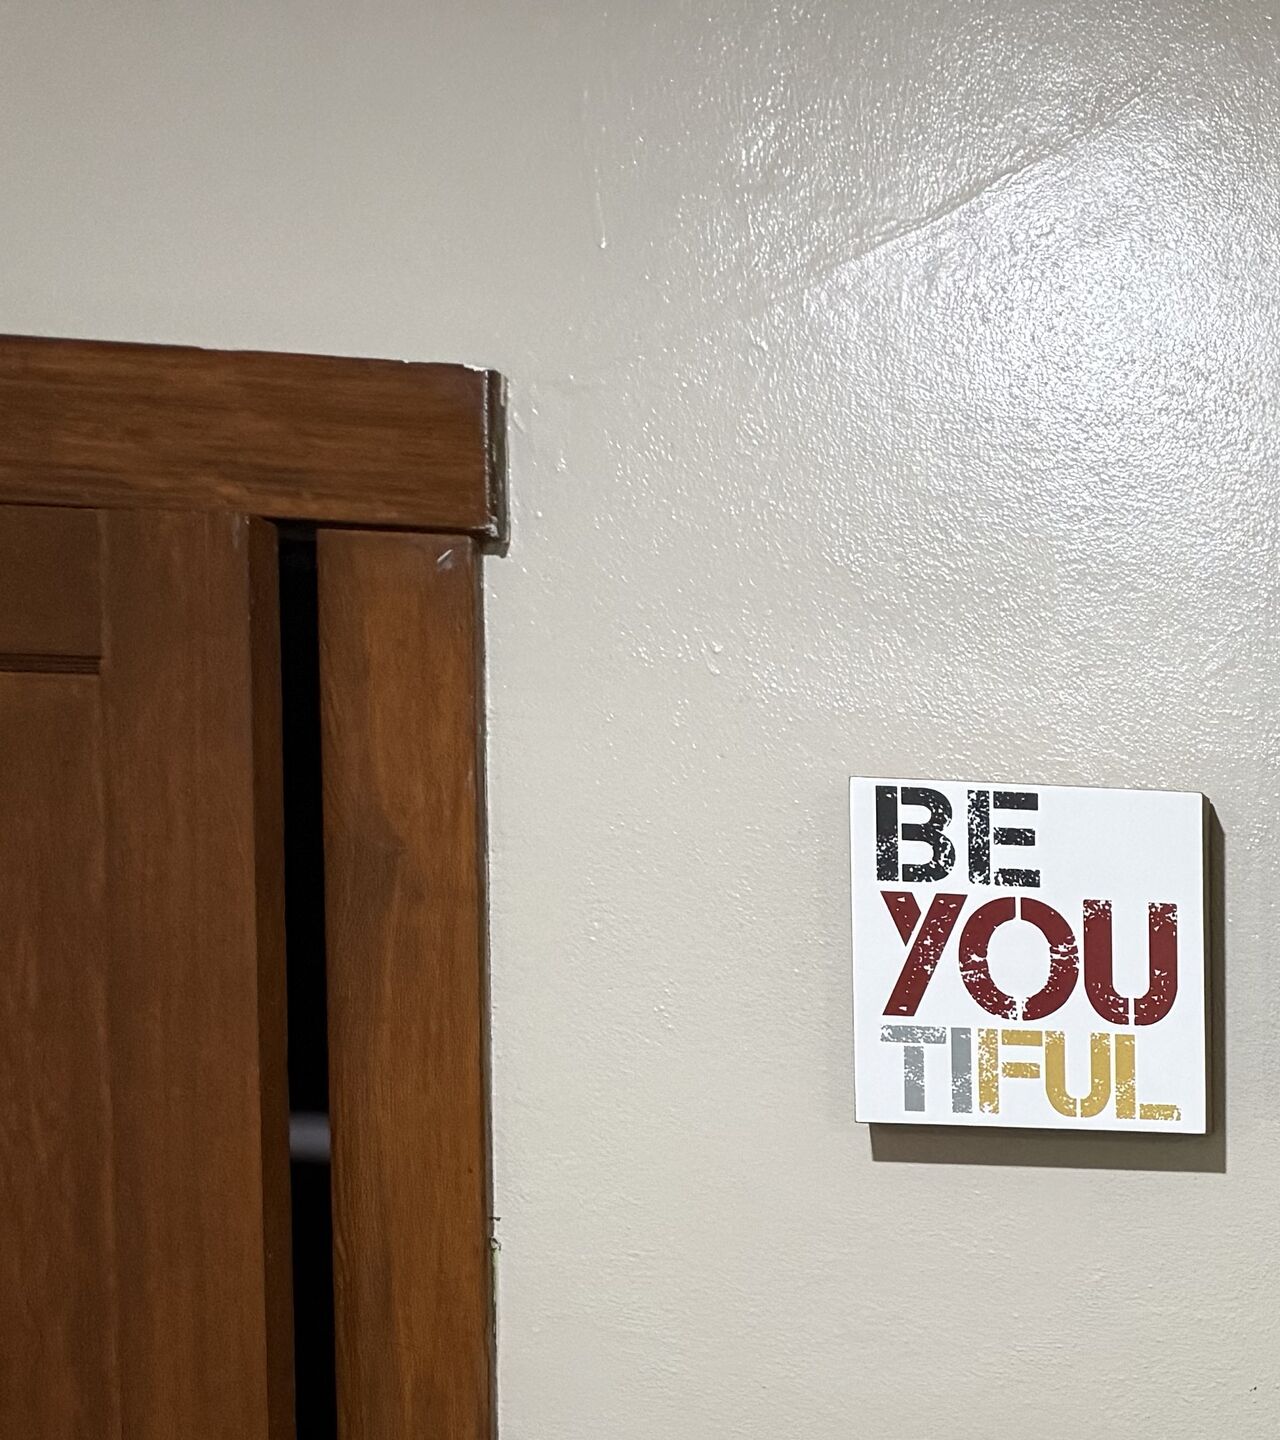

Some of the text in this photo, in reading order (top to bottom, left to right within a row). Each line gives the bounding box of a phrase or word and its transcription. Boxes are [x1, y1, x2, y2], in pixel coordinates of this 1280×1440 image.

[875, 785, 1041, 888] BE
[880, 890, 1179, 1026] YOU
[880, 1025, 1182, 1121] TIFUL
